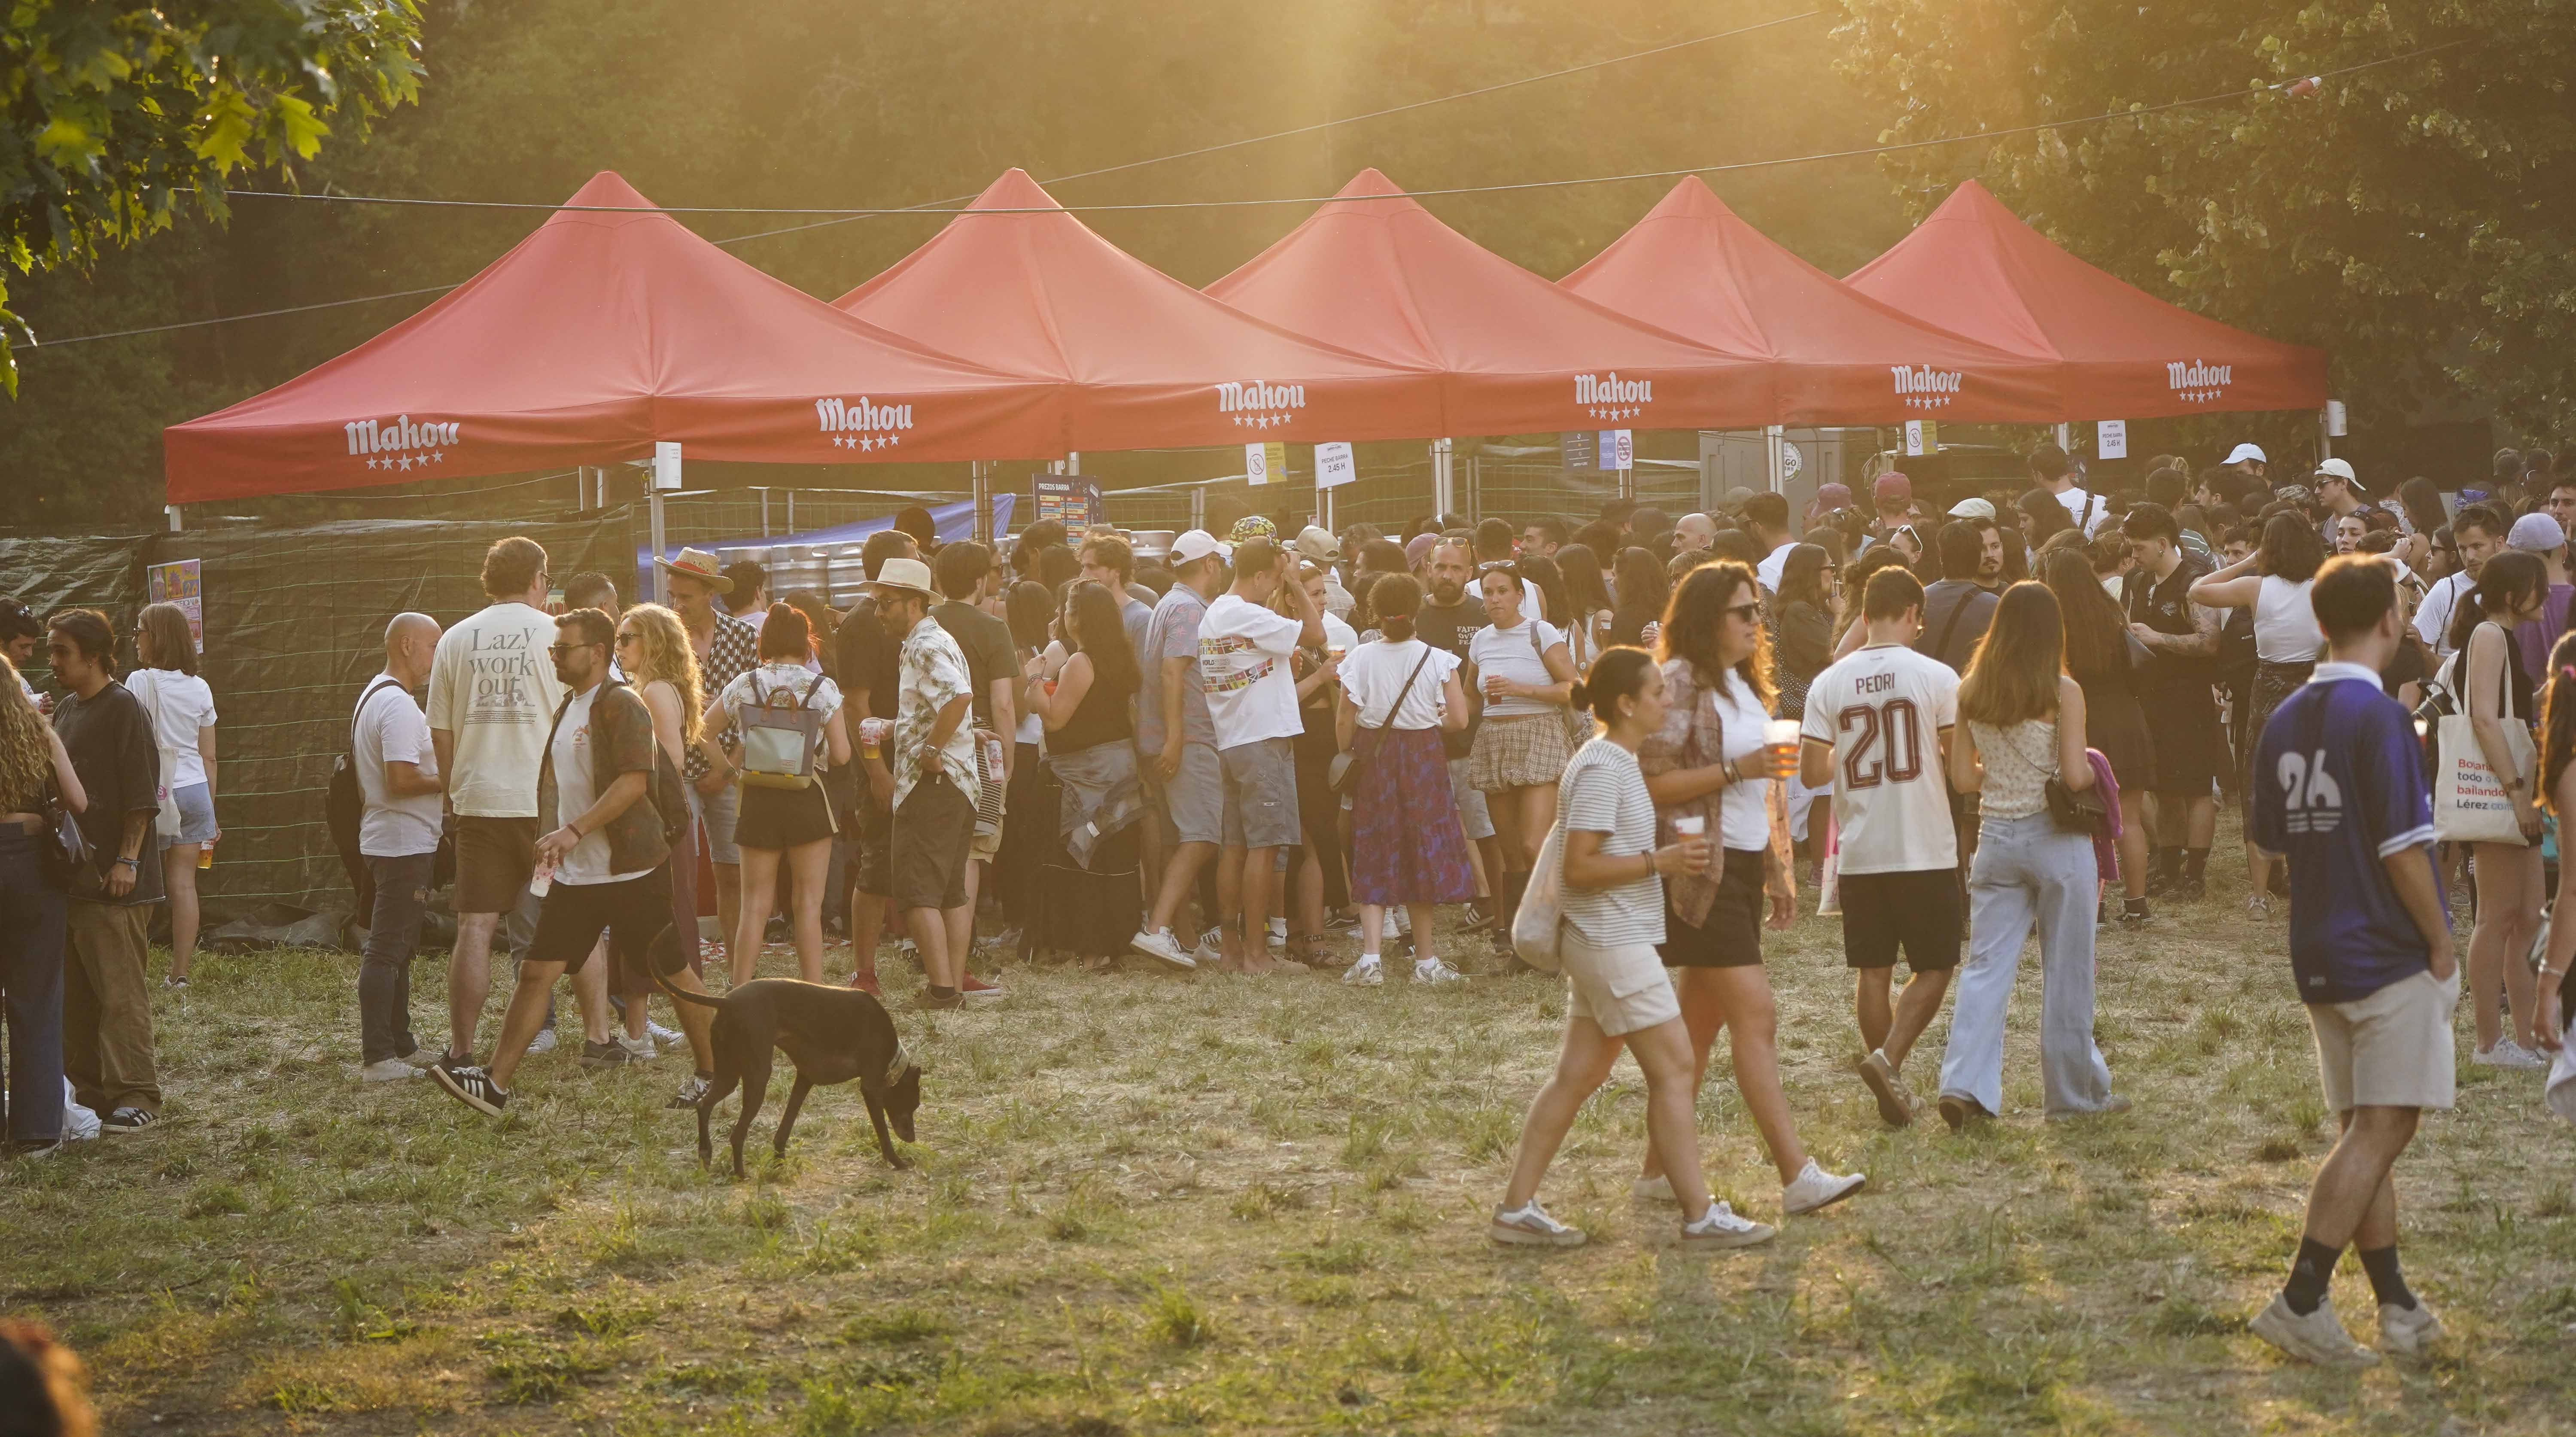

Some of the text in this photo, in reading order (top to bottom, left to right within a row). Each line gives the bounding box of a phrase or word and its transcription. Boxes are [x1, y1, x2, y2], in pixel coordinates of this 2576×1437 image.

[1891, 364, 1962, 394] Mahou
[2167, 358, 2231, 389] Mahou
[1216, 380, 1305, 412] Mahou
[1575, 372, 1652, 404] Mahou
[815, 396, 913, 431] Mahou
[345, 415, 459, 455] Mahou
[1328, 464, 1340, 473] 2.45
[471, 628, 537, 652] Lazy
[468, 651, 535, 676] work
[478, 676, 520, 695] out
[1856, 672, 1895, 695] PEDRI
[1837, 697, 1923, 791] 20
[2277, 749, 2342, 833] 26
[2457, 772, 2482, 783] todo
[2457, 784, 2505, 797] bailando
[2457, 799, 2488, 810] Lérez
